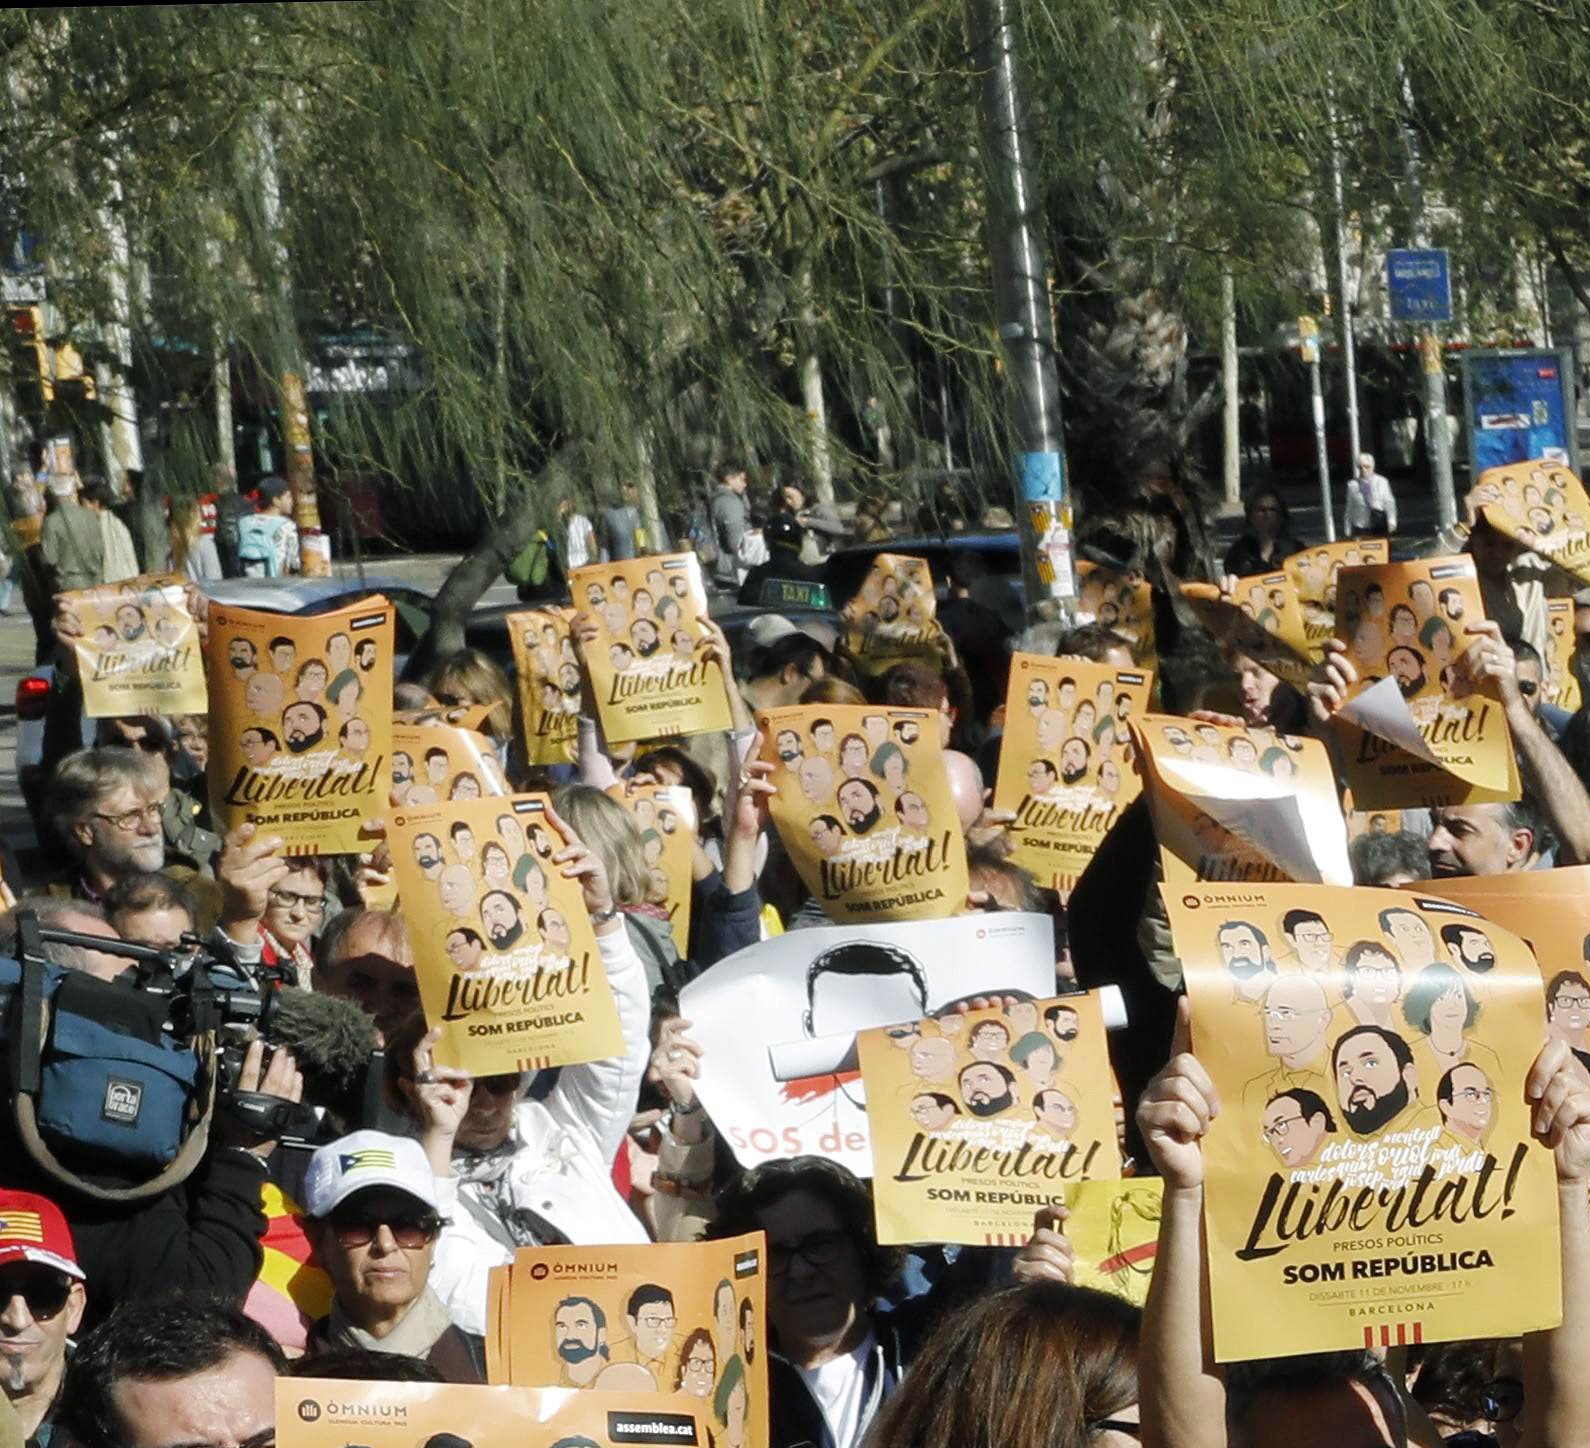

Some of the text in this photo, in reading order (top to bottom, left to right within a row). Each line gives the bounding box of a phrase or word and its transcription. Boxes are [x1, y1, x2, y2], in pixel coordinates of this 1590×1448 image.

[608, 660, 707, 704] Llibertat!
[226, 755, 380, 808] Llibertat!
[444, 952, 591, 1022] Llibertat!
[468, 1012, 585, 1037] SOM REPÚBLICA
[894, 1132, 1101, 1182] Llibertat!
[1235, 1144, 1518, 1262] Llibertat!
[1282, 1249, 1494, 1285] SOM REPÚBLICA
